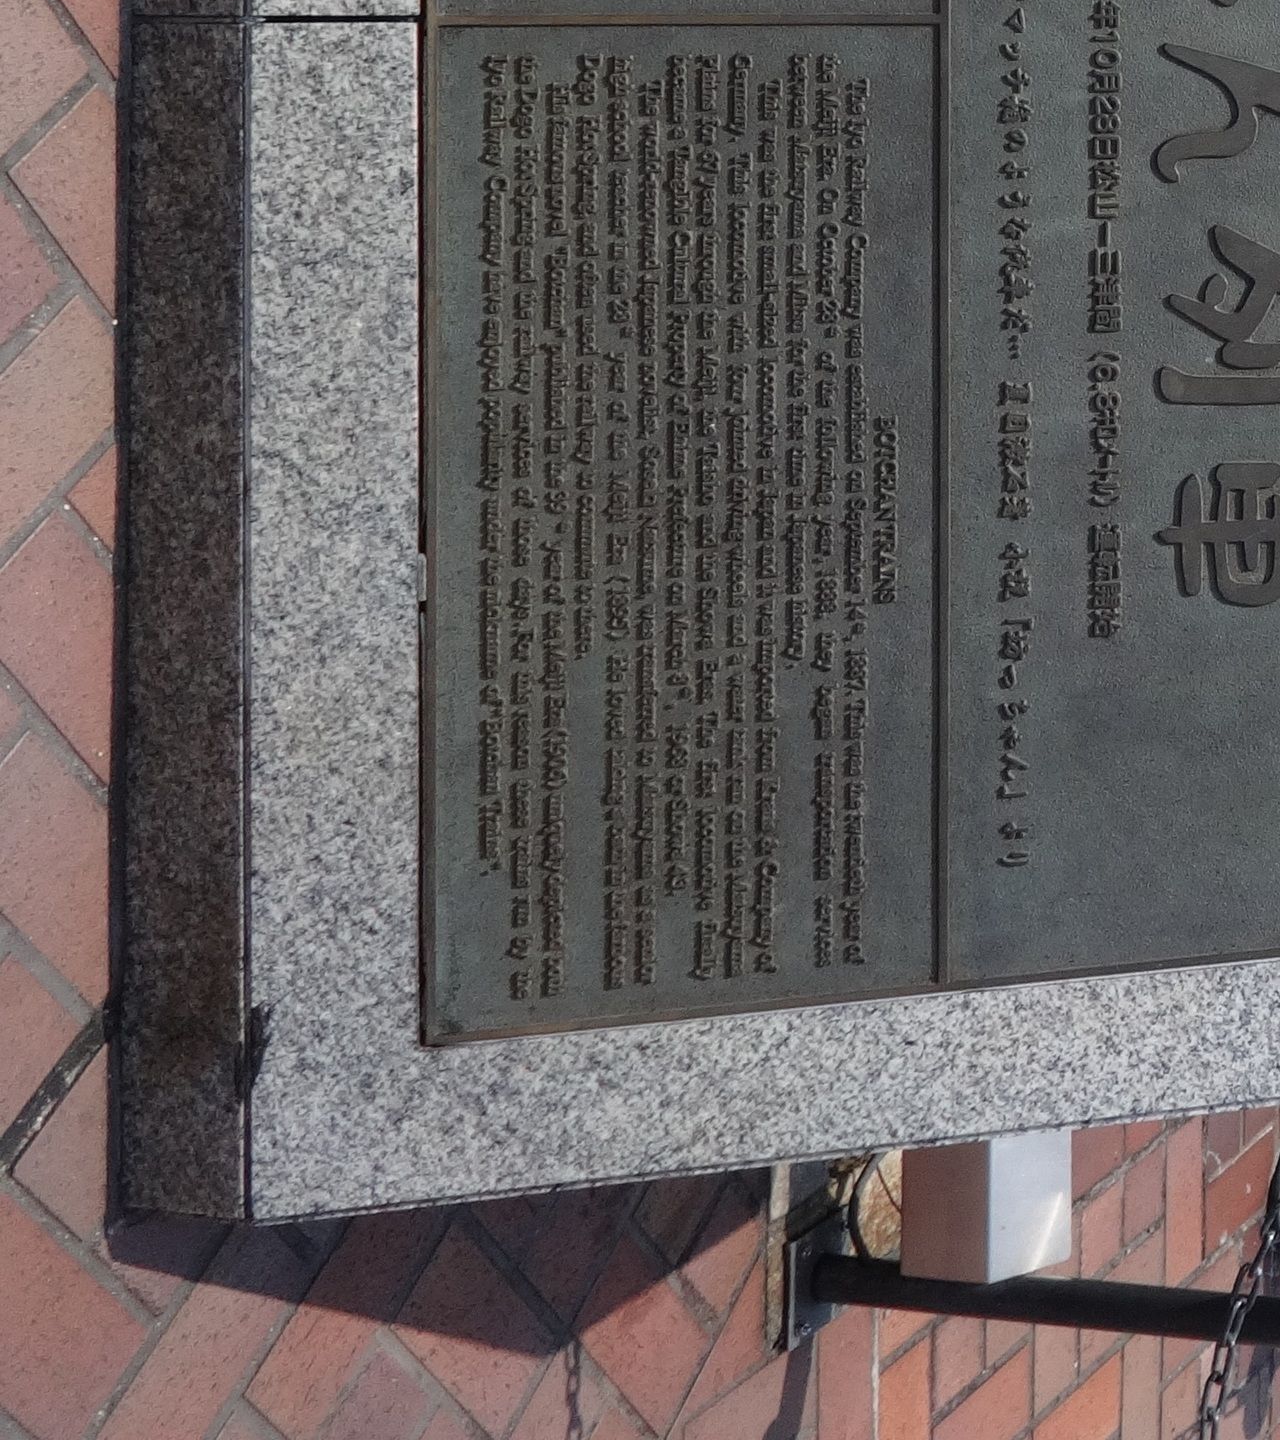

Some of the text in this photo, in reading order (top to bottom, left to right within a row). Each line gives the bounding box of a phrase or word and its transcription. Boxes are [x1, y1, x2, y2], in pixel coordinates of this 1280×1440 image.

[546, 82, 572, 114] His
[573, 54, 603, 106] Dogo
[604, 55, 634, 98] high
[638, 79, 664, 116] The
[668, 55, 693, 124] became
[697, 54, 722, 111] Plains
[788, 54, 811, 129] between
[847, 78, 869, 115] The
[478, 90, 510, 166] Railway
[511, 88, 542, 139] Dogo
[608, 100, 634, 161] school
[814, 87, 841, 138] Meiji
[545, 117, 572, 182] famous
[697, 149, 722, 173] 67
[728, 152, 753, 194] This
[510, 182, 541, 246] Spring
[545, 184, 571, 237] novel
[607, 168, 633, 237] teacher
[637, 121, 663, 271] world-renowned
[663, 145, 693, 225] Tangible
[693, 174, 718, 227] years
[784, 134, 810, 239] Matsuyama
[843, 154, 869, 226] Railway
[477, 174, 509, 267] Company
[667, 231, 693, 306] Cultural
[692, 231, 722, 304] through
[728, 201, 752, 305] locomotive
[817, 222, 840, 296] October
[842, 232, 869, 319] Company
[481, 271, 509, 313] have
[576, 262, 602, 308] often
[633, 273, 662, 357] Japanese
[787, 281, 810, 334] Mitsu
[476, 317, 508, 392] enjoyed
[509, 327, 540, 394] railway
[576, 315, 602, 357] used
[662, 310, 692, 388] Property
[728, 311, 752, 353] with
[540, 344, 570, 430] published
[602, 351, 628, 393] year
[727, 363, 752, 404] four
[476, 396, 508, 491] popularity
[513, 403, 540, 478] services
[571, 395, 601, 464] railway
[723, 408, 751, 472] jointed
[787, 403, 809, 440] first
[846, 364, 868, 464] established
[666, 419, 692, 480] Ehime
[696, 441, 721, 506] Taisho
[787, 448, 809, 488] time
[812, 416, 839, 506] following
[480, 497, 507, 551] under
[602, 470, 631, 523] Meiji
[751, 79, 783, 949] This first small-sized locomotive Japan imported from Company
[872, 414, 899, 605] BOTCHAN TRAINS
[512, 517, 539, 568] those
[574, 494, 601, 579] commute
[605, 532, 631, 566] Era
[665, 482, 692, 578] Prefecture
[782, 514, 809, 595] Japanese
[841, 497, 868, 593] September
[539, 541, 565, 583] year
[479, 584, 506, 680] nickname
[665, 610, 692, 670] March
[695, 586, 721, 650] Showa
[538, 644, 569, 691] Meiji
[811, 632, 838, 671] they
[511, 670, 538, 705] this
[542, 694, 568, 729] Era
[604, 689, 630, 741] loved
[635, 643, 660, 743] transferred
[726, 672, 750, 721] water
[810, 682, 837, 741] began
[511, 711, 534, 771] reason
[695, 711, 721, 749] The
[725, 728, 750, 770] tank
[845, 699, 868, 740] This
[510, 778, 537, 829] these
[600, 748, 629, 806] taking
[695, 760, 720, 799] first
[537, 794, 568, 872] uniquely
[630, 774, 659, 880] Matsuyama
[664, 799, 691, 860] Showa
[810, 752, 837, 881] transportation
[510, 836, 537, 889] trains
[694, 808, 720, 910] locomotive
[844, 813, 867, 896] twentieth
[536, 874, 567, 953] depicted
[720, 873, 749, 979] Matsuyama
[813, 895, 836, 968] services
[840, 899, 863, 942] year
[540, 956, 567, 998] both
[603, 921, 628, 990] famous
[633, 929, 658, 985] senior
[690, 919, 720, 981] finally
